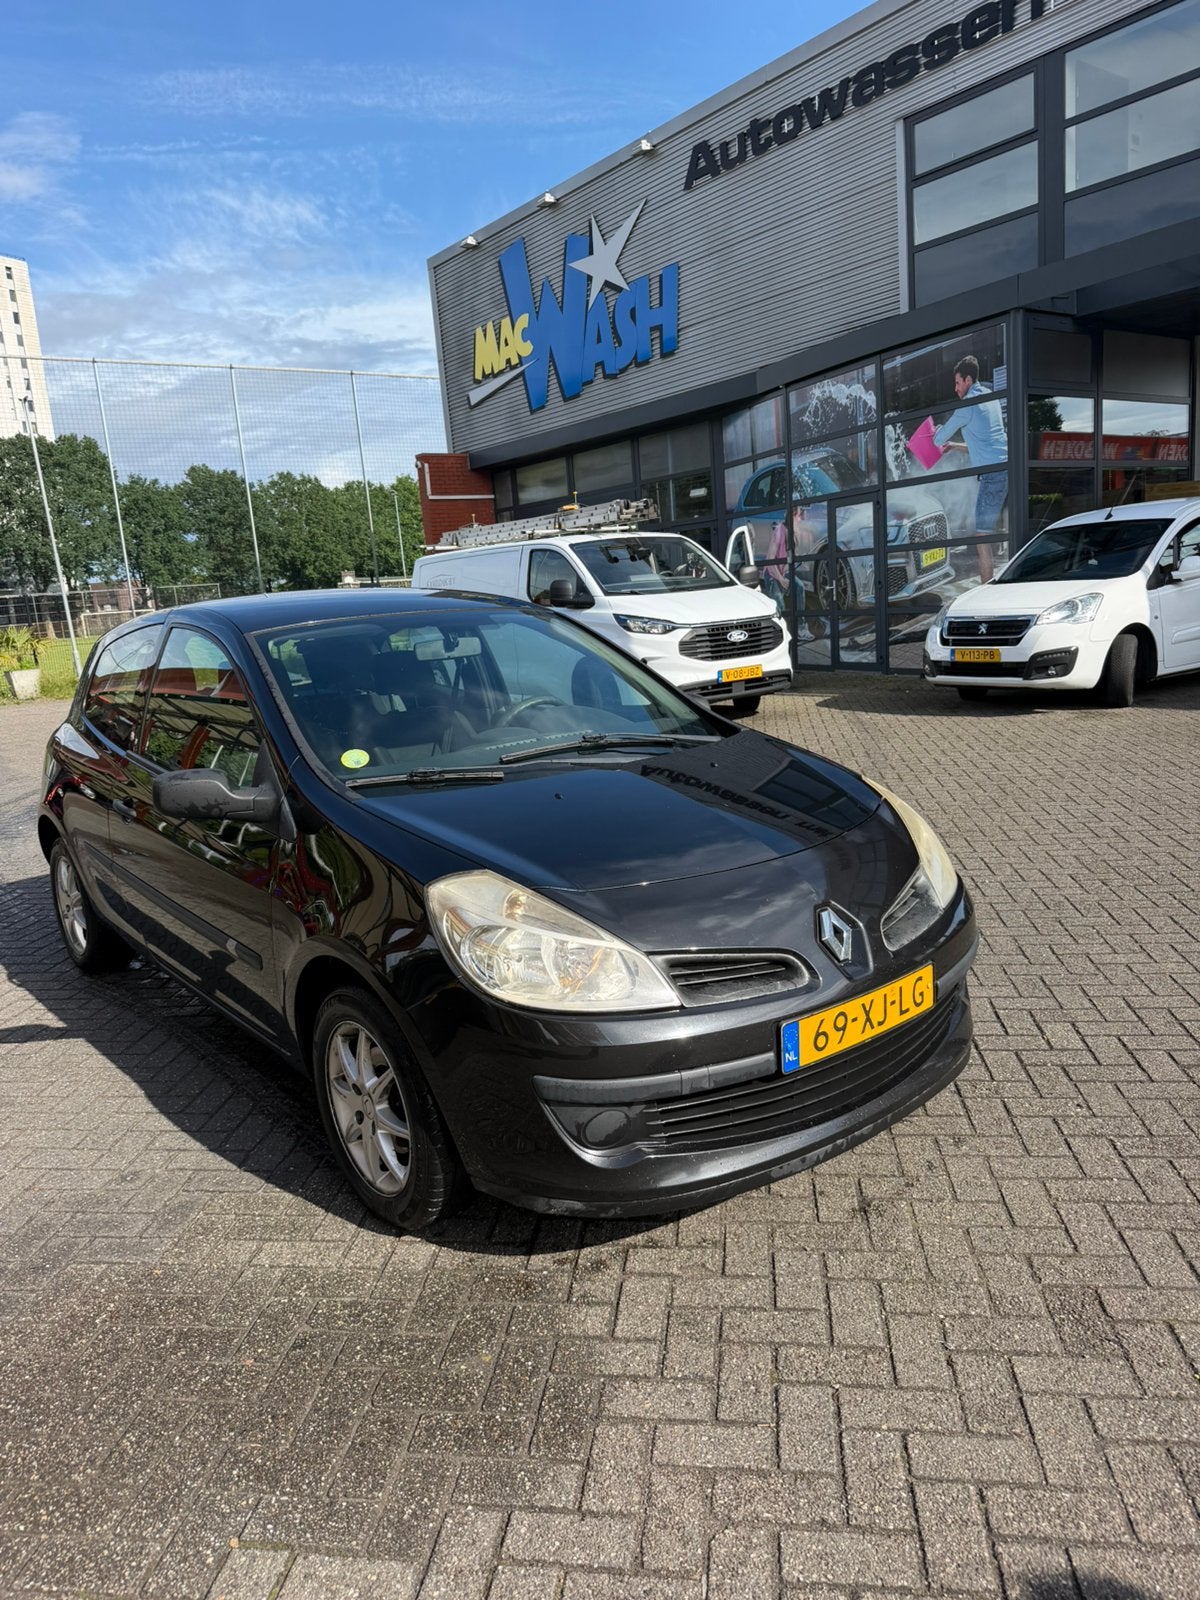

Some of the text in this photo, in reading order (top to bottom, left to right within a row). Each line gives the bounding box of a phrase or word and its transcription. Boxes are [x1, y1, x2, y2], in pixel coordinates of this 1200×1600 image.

[474, 233, 679, 412] MAC WASH
[960, 650, 995, 661] V-113-PB
[725, 666, 760, 680] V-08-JBZ
[813, 976, 924, 1052] 69-XJ-LG
[785, 1051, 798, 1062] NL
